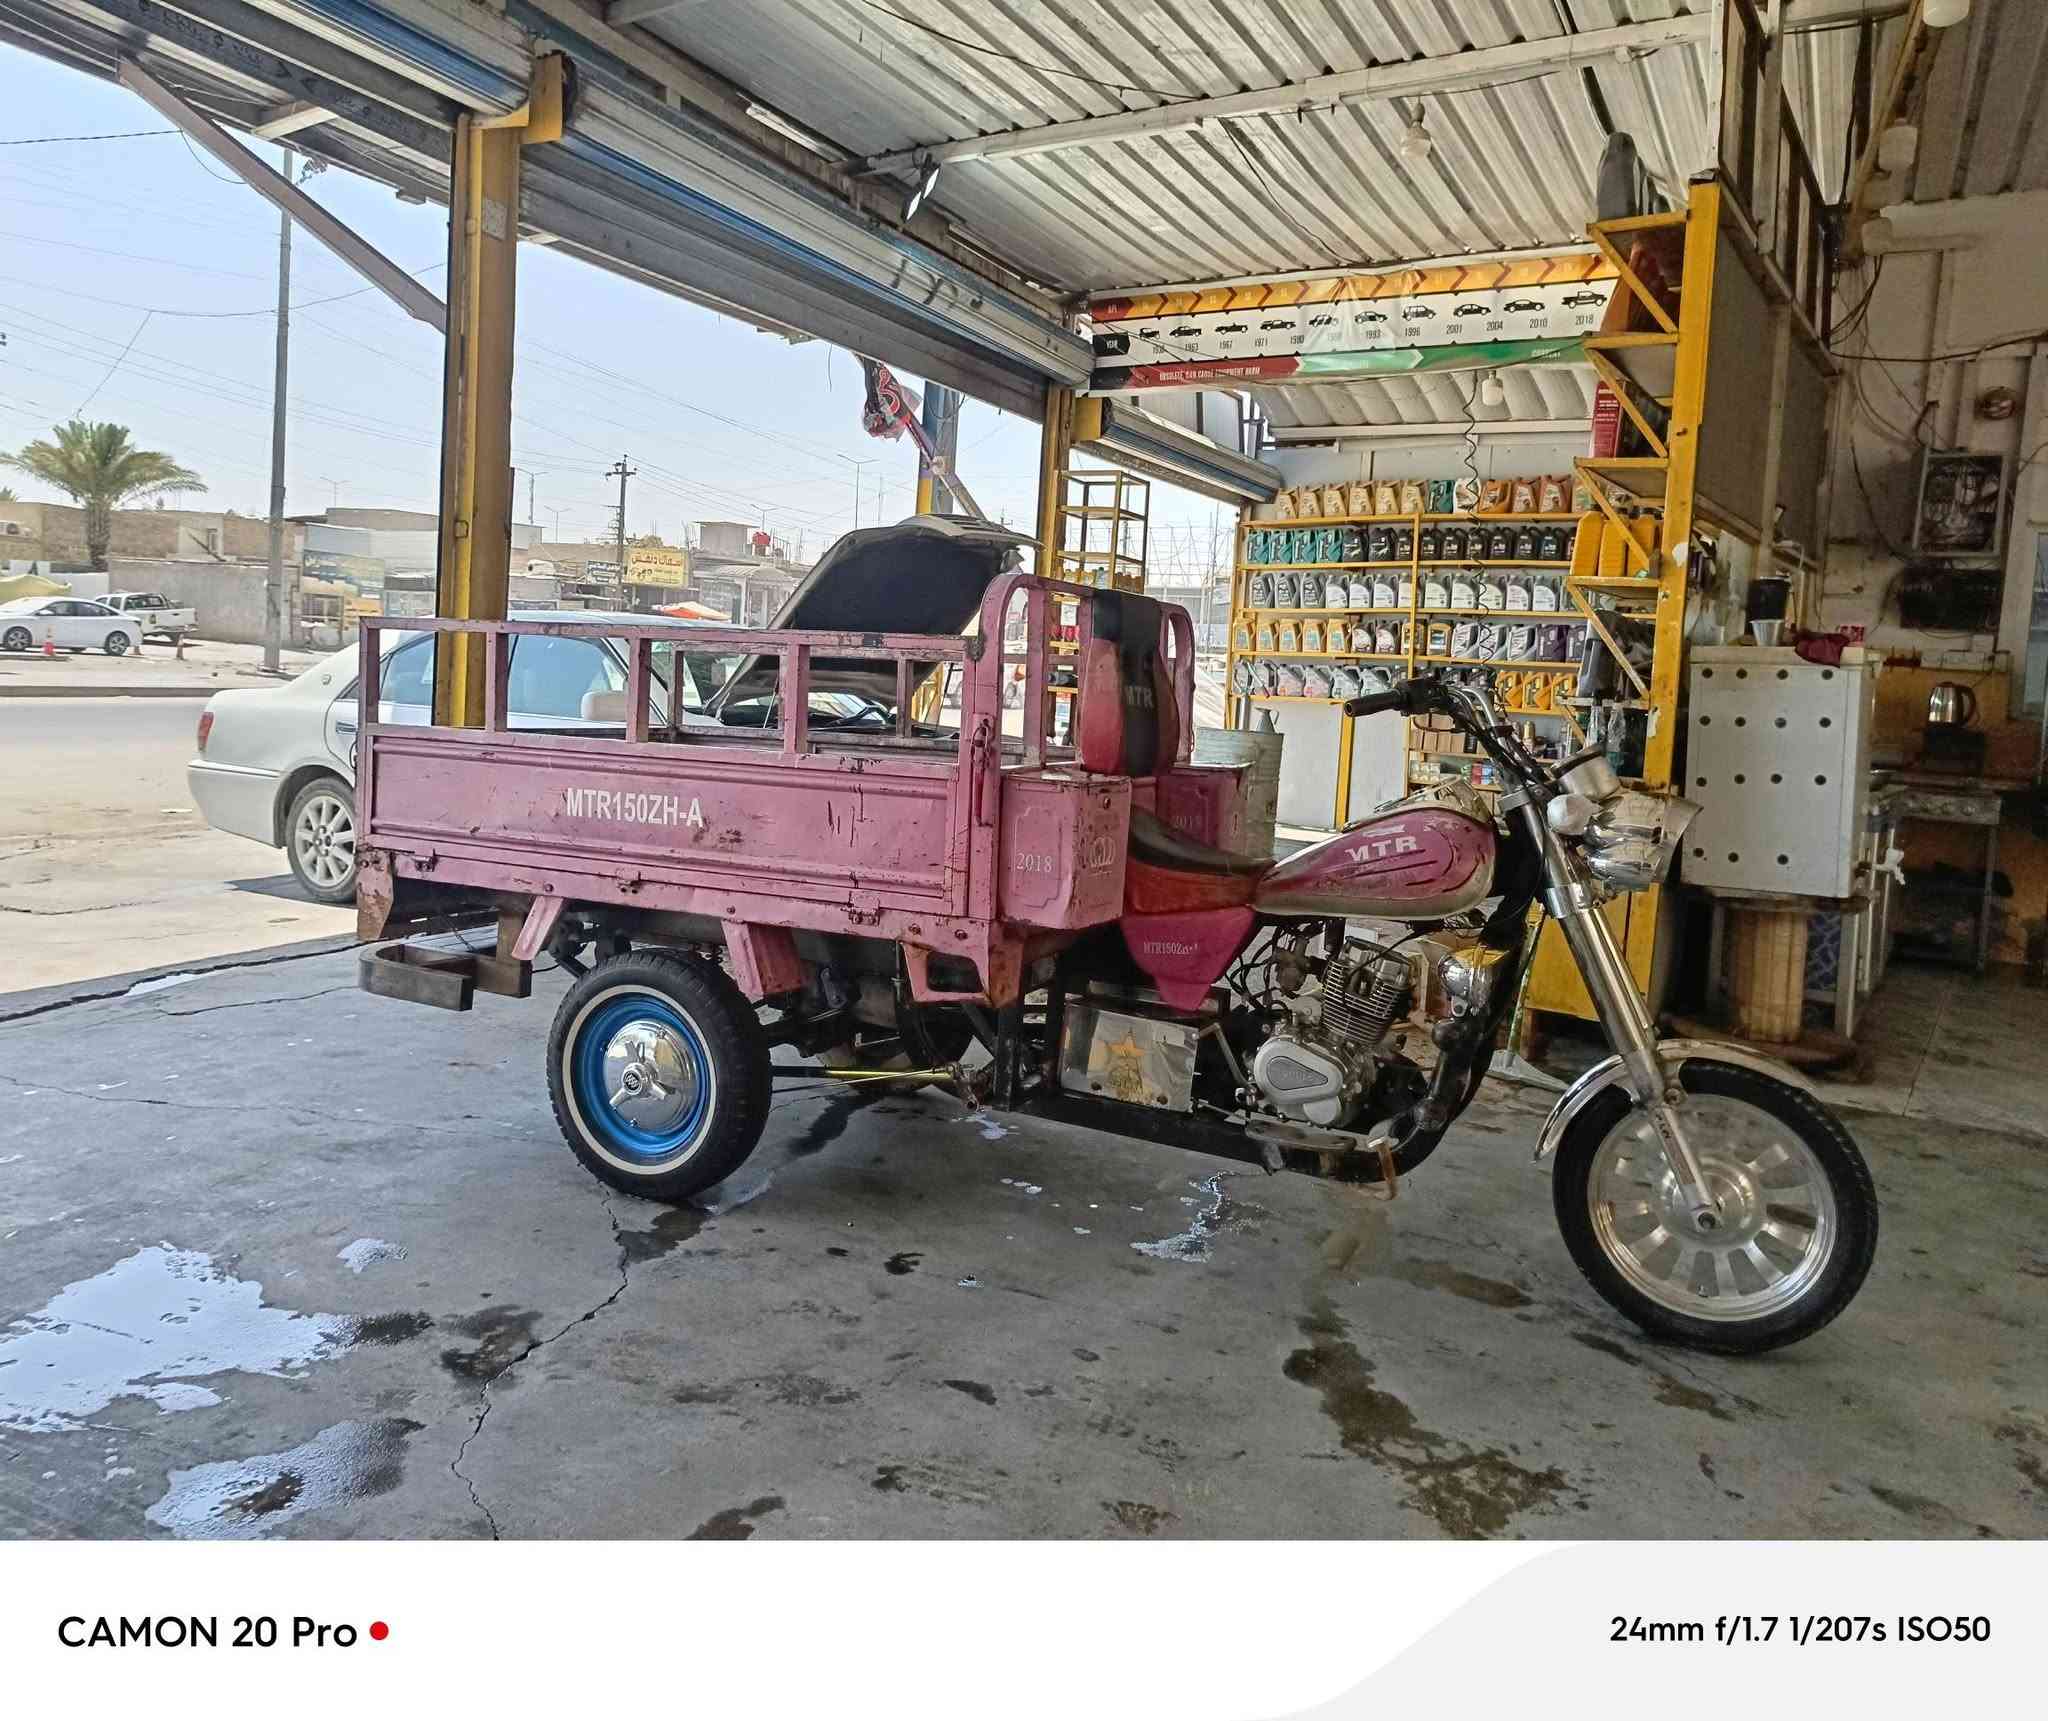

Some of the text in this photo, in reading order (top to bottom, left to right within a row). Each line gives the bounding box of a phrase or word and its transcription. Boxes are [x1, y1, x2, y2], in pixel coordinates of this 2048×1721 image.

[1219, 339, 1233, 350] 1967
[1446, 323, 1463, 335] 2001
[1486, 320, 1504, 331] 2004
[1529, 318, 1548, 329] 2010
[1575, 315, 1594, 326] 2018
[566, 787, 704, 828] MTR150ZH-A
[1016, 852, 1053, 873] 2018
[1345, 836, 1418, 862] MTR
